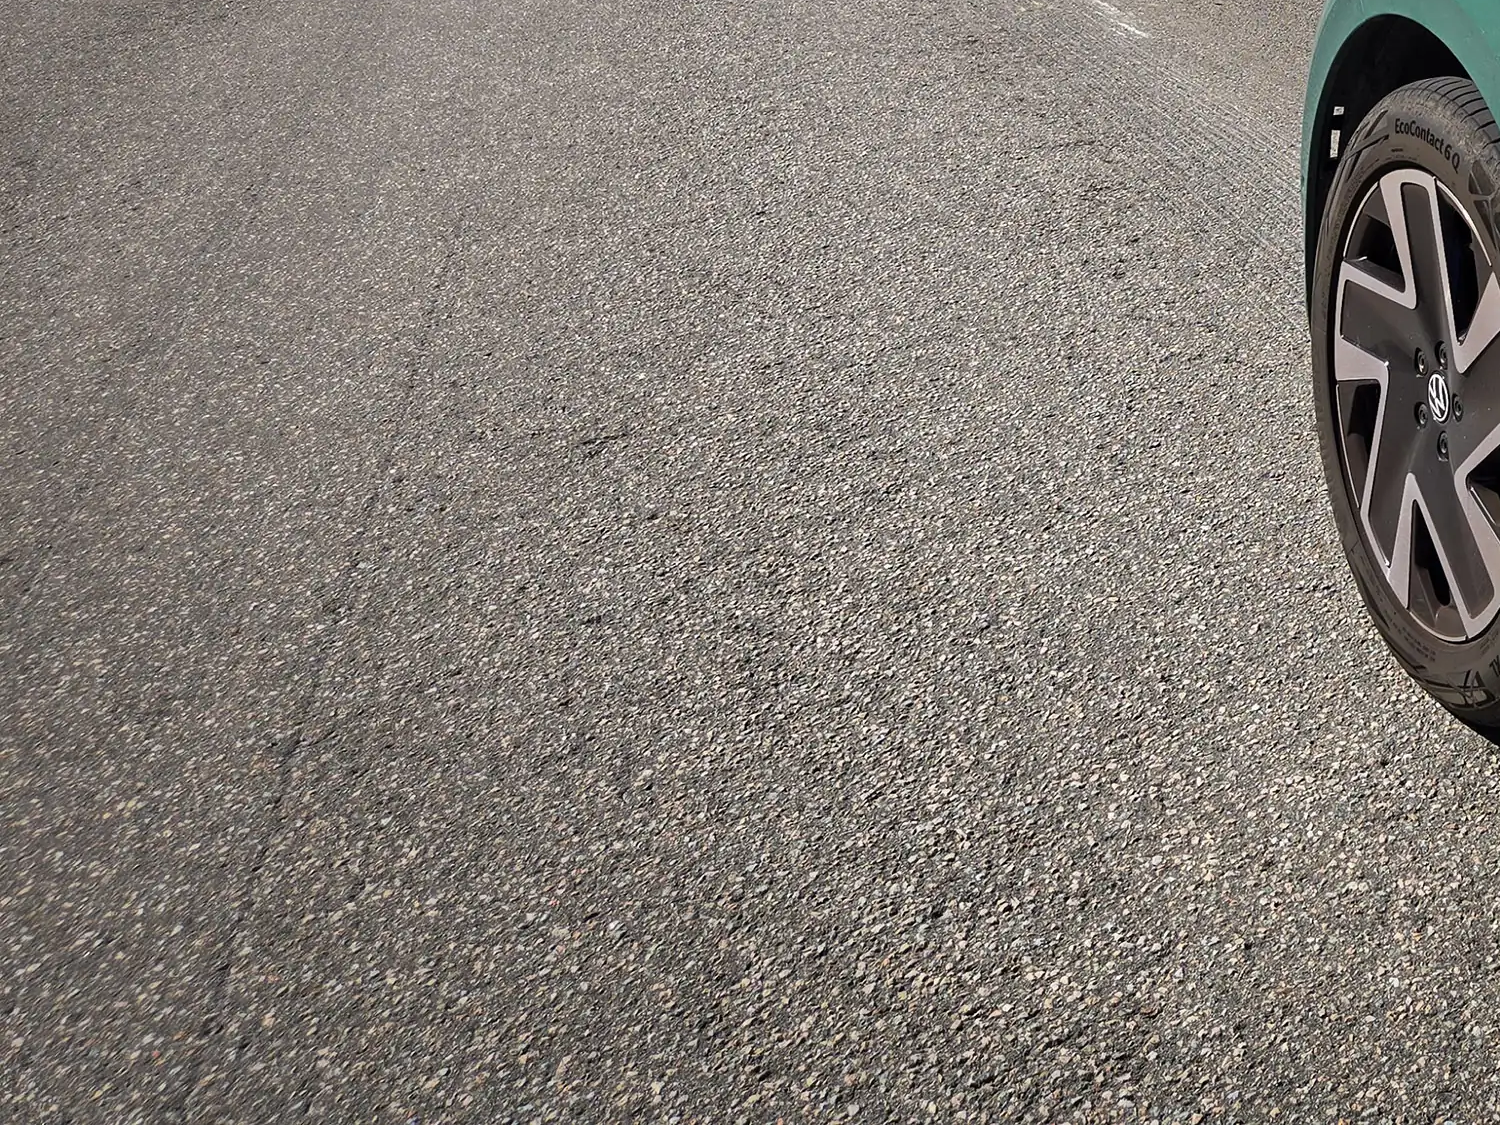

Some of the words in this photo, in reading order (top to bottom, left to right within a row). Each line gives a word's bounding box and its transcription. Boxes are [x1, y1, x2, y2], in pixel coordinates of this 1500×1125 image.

[1394, 118, 1445, 153] EcoContact
[1444, 141, 1453, 160] 6
[1452, 152, 1461, 174] Q
